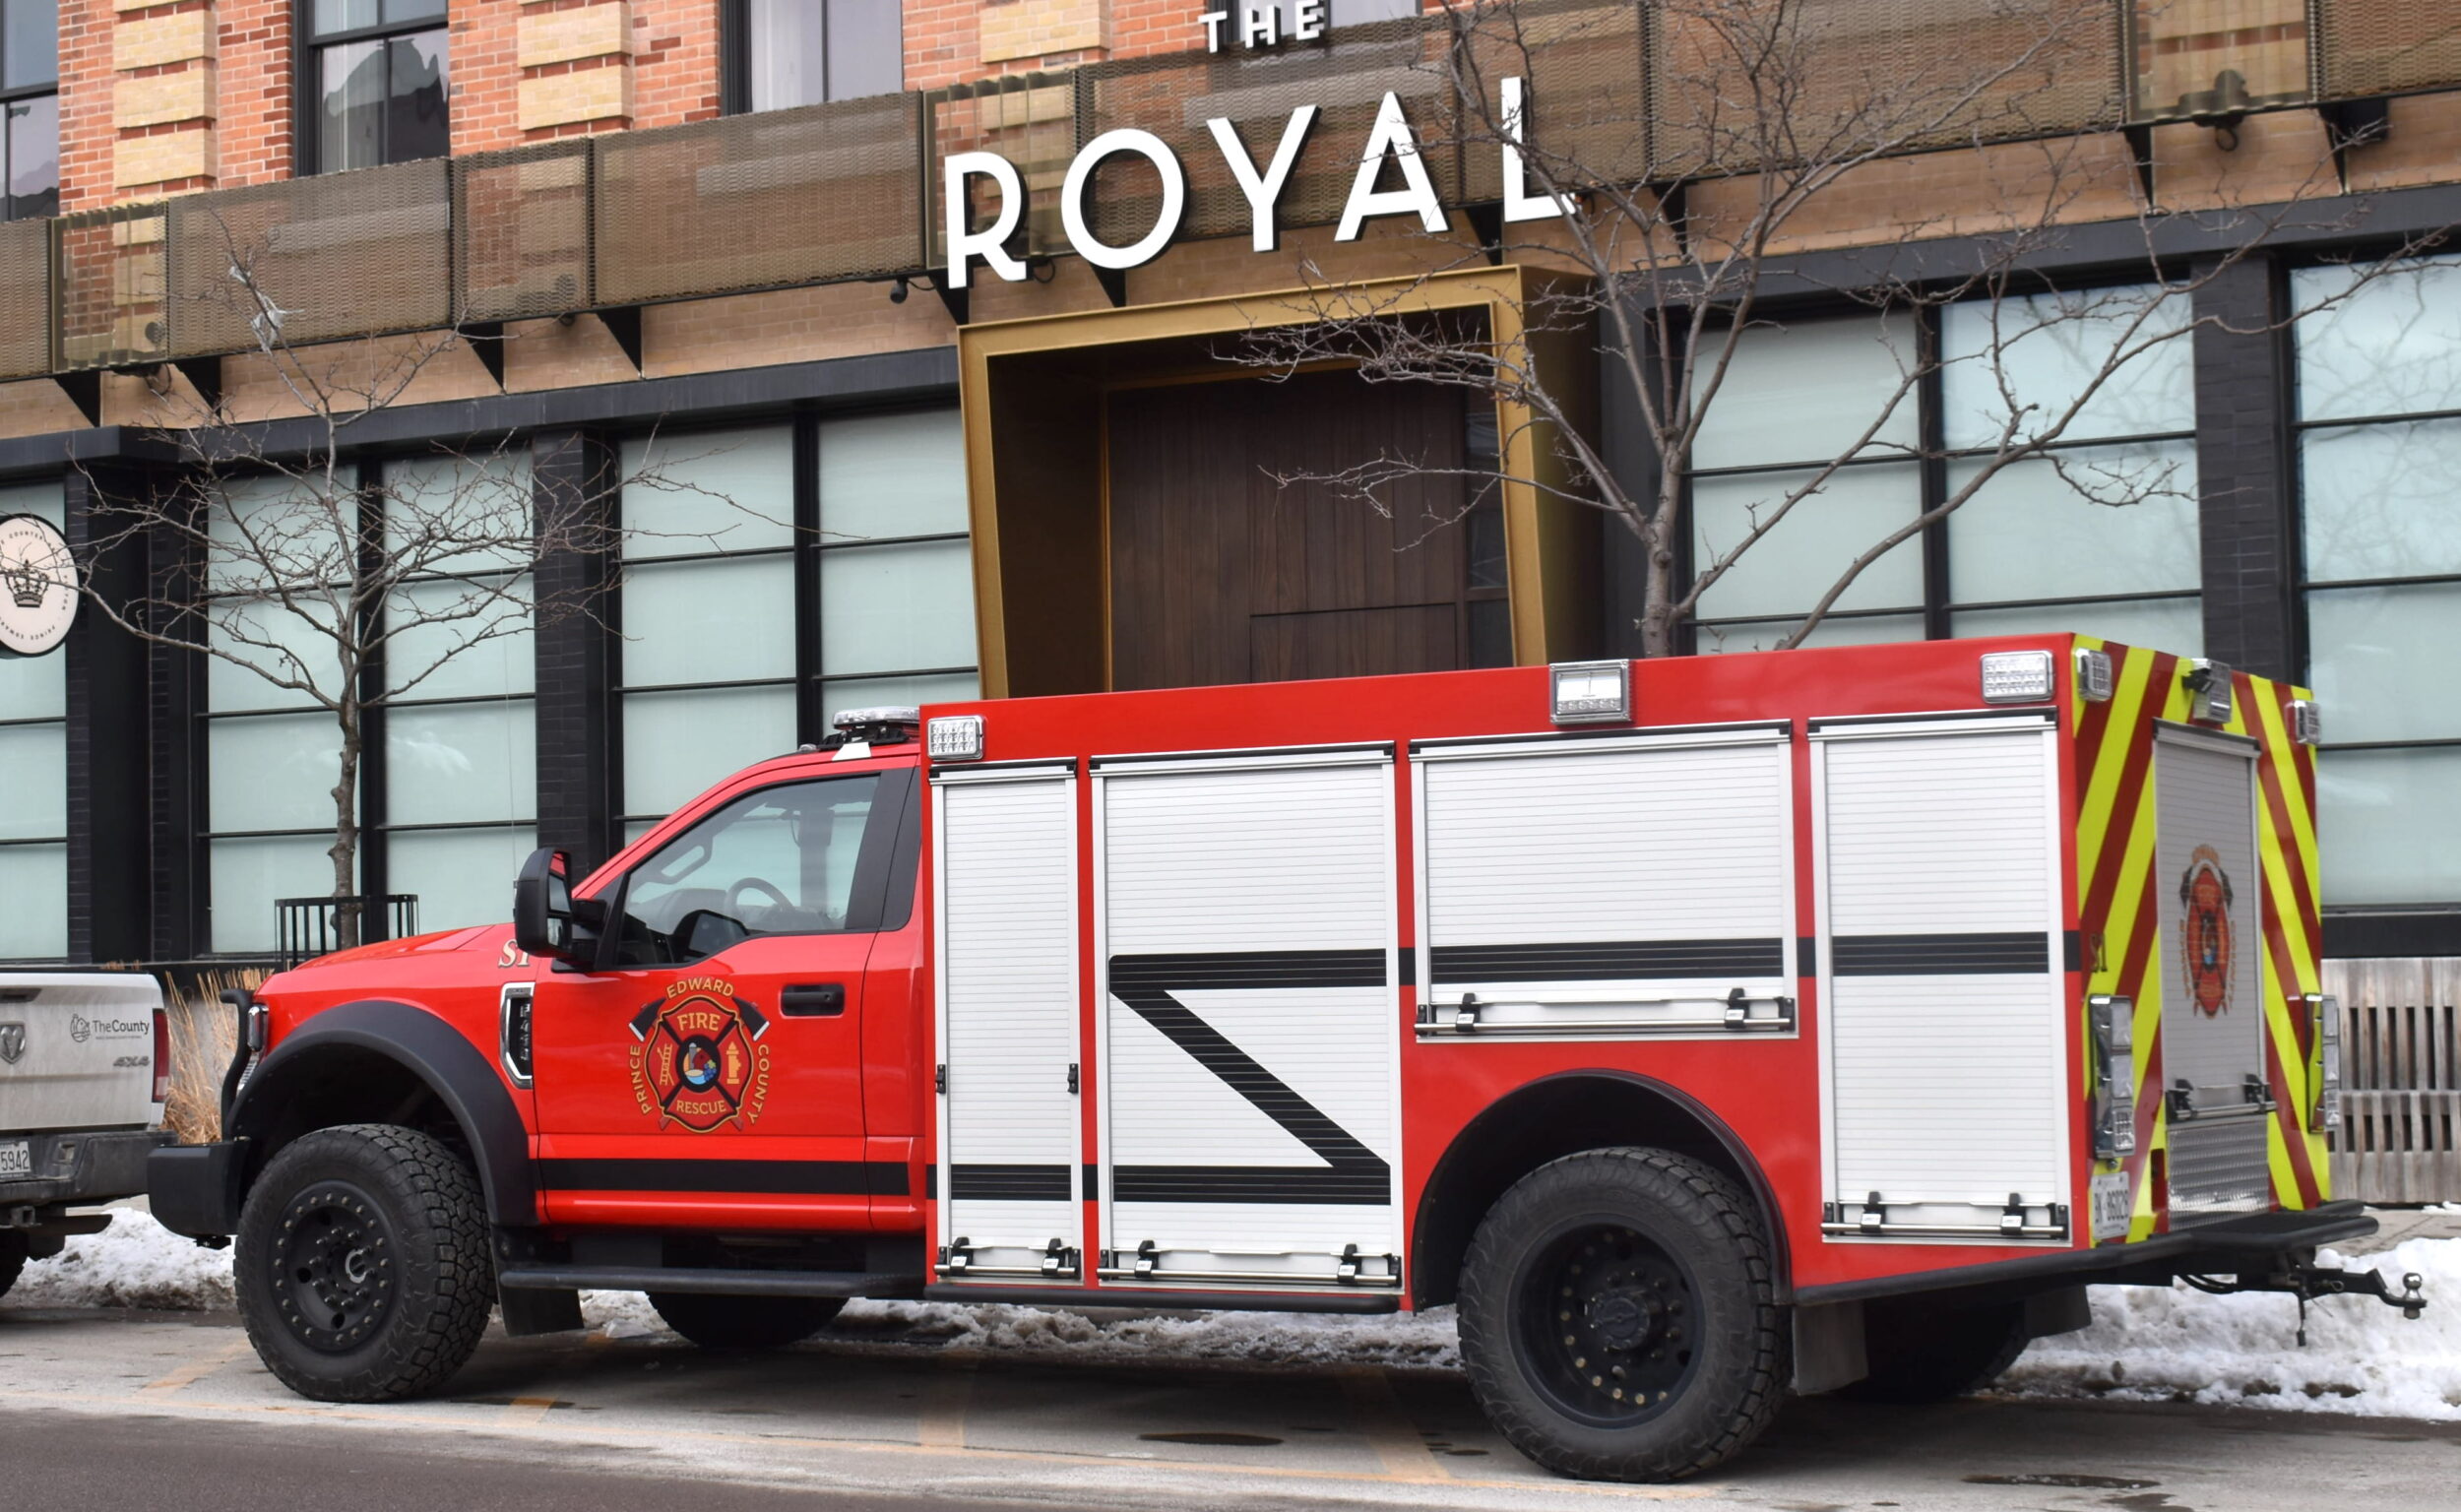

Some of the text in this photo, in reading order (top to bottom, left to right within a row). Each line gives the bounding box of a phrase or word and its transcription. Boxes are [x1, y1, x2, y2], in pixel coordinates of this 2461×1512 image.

[1198, 0, 1322, 53] THE
[944, 76, 1577, 288] ROYAL
[666, 977, 734, 998] EDWARD
[677, 1012, 722, 1031] FIRE
[630, 1044, 653, 1114] PRINCE
[747, 1044, 770, 1124] COUNTY
[676, 1100, 726, 1114] RESCUE
[0, 1149, 30, 1170] 5942
